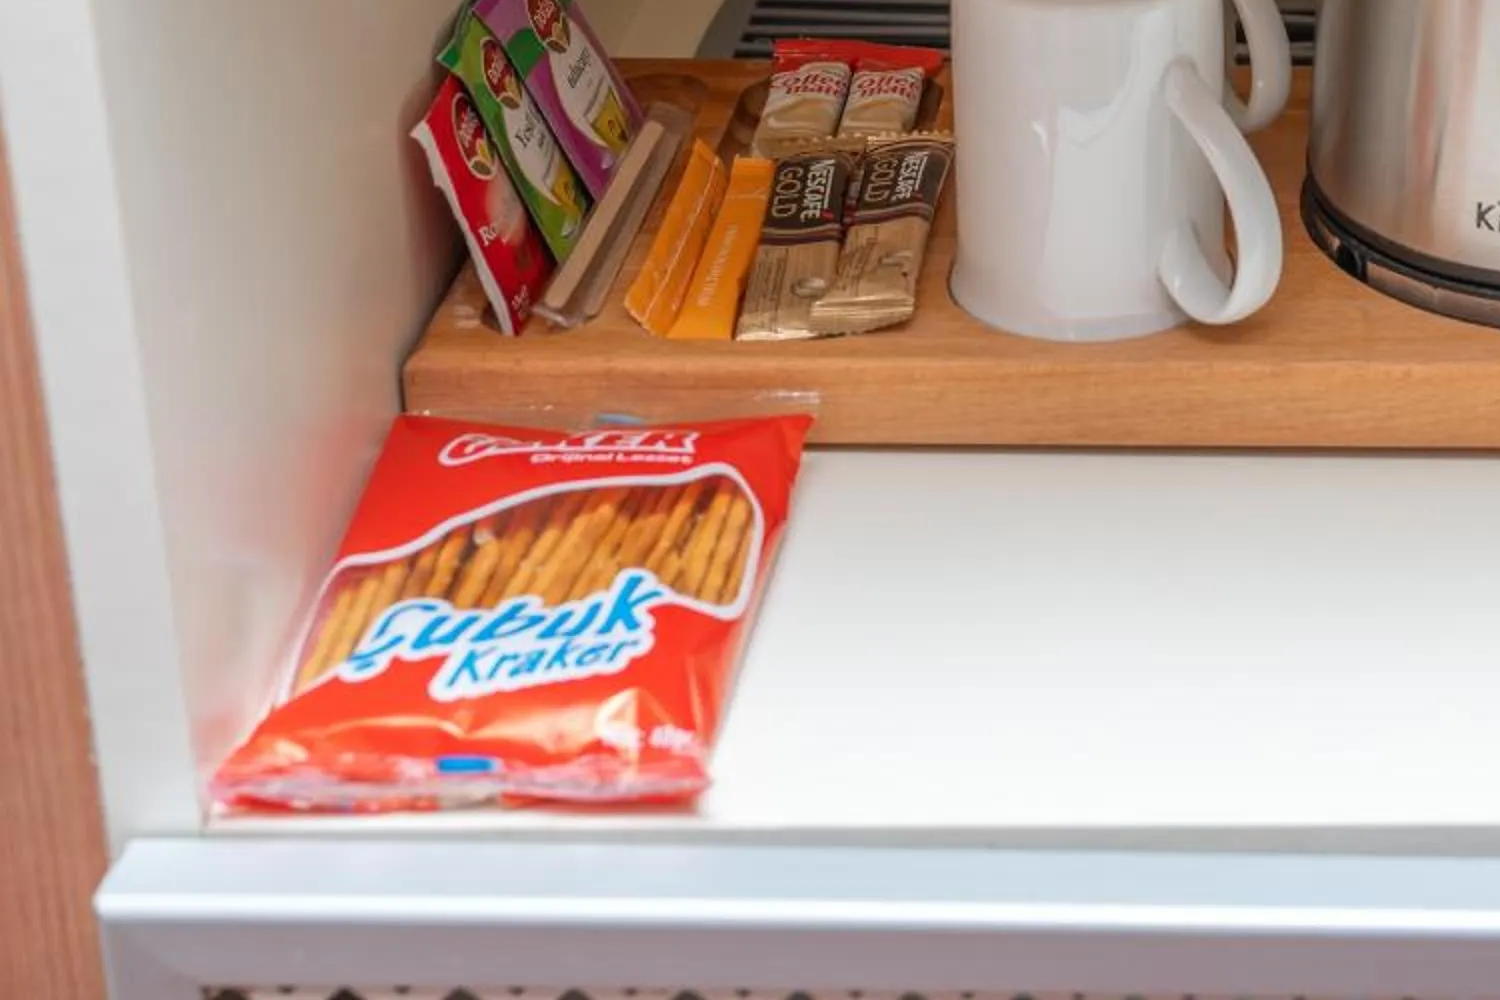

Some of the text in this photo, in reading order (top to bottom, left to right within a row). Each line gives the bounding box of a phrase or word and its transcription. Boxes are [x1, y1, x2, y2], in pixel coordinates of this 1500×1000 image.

[771, 167, 804, 218] GOLD
[863, 157, 899, 201] GOLD
[348, 575, 664, 672] Çubuk
[447, 638, 640, 688] Kraker
